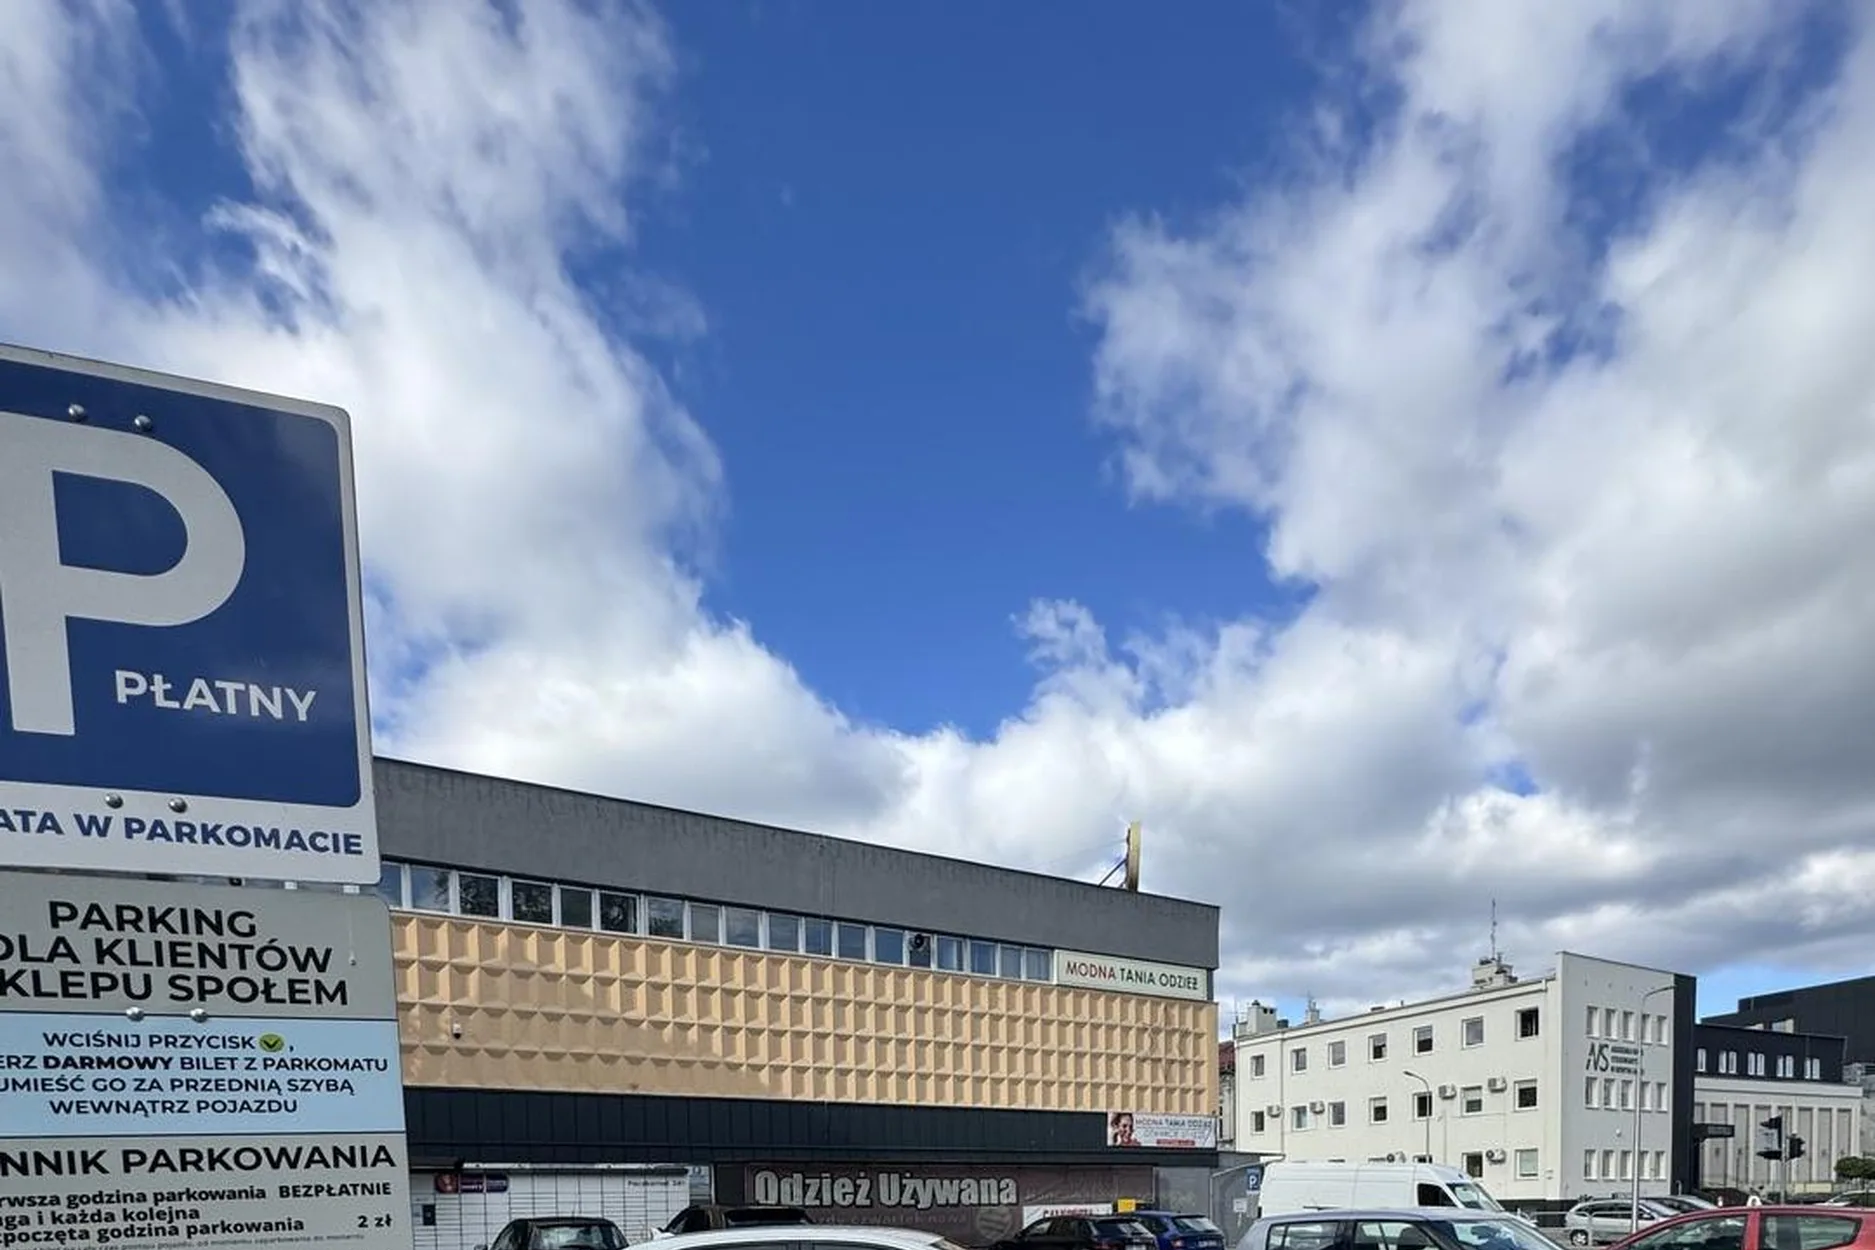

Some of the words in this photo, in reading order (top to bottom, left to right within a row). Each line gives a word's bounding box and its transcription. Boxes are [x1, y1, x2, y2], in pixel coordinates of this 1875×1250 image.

[0, 411, 245, 736] P
[115, 670, 316, 721] PŁATNY
[73, 813, 113, 838] W
[124, 817, 363, 855] PARKOMACIE
[50, 900, 257, 938] PARKING
[95, 937, 333, 973] KLIENTÓW
[1065, 961, 1116, 981] MODNA
[1119, 968, 1156, 985] TANIA
[168, 973, 348, 1006] SPOŁEM
[43, 1029, 141, 1049] WCIŚNIJ
[149, 1034, 255, 1050] PRZYCISK
[43, 1055, 173, 1071] DARMOWY
[180, 1056, 236, 1071] BILET
[244, 1057, 258, 1071] Z
[263, 1057, 389, 1072] PARKOMATU
[92, 1078, 126, 1092] GO
[133, 1078, 163, 1092] ZA
[171, 1079, 283, 1096] PRZEDNIĄ
[287, 1079, 354, 1096] SZYBĄ
[49, 1099, 190, 1118] WEWNĄTRZ
[197, 1100, 298, 1115] POJAZDU
[121, 1144, 396, 1175] PARKOWANIA
[67, 1189, 149, 1209] godzina
[153, 1185, 266, 1207] parkowania
[278, 1181, 392, 1199] BEZPŁATNIE
[755, 1170, 871, 1206] Odzież
[878, 1172, 1017, 1209] Używana
[0, 1226, 90, 1248] poczęta
[97, 1223, 180, 1244] godzina
[186, 1217, 304, 1238] parkowania
[357, 1215, 369, 1228] 2
[374, 1213, 392, 1228] zł
[37, 1210, 44, 1226] i
[51, 1208, 116, 1225] każda
[122, 1205, 200, 1225] kolejna
